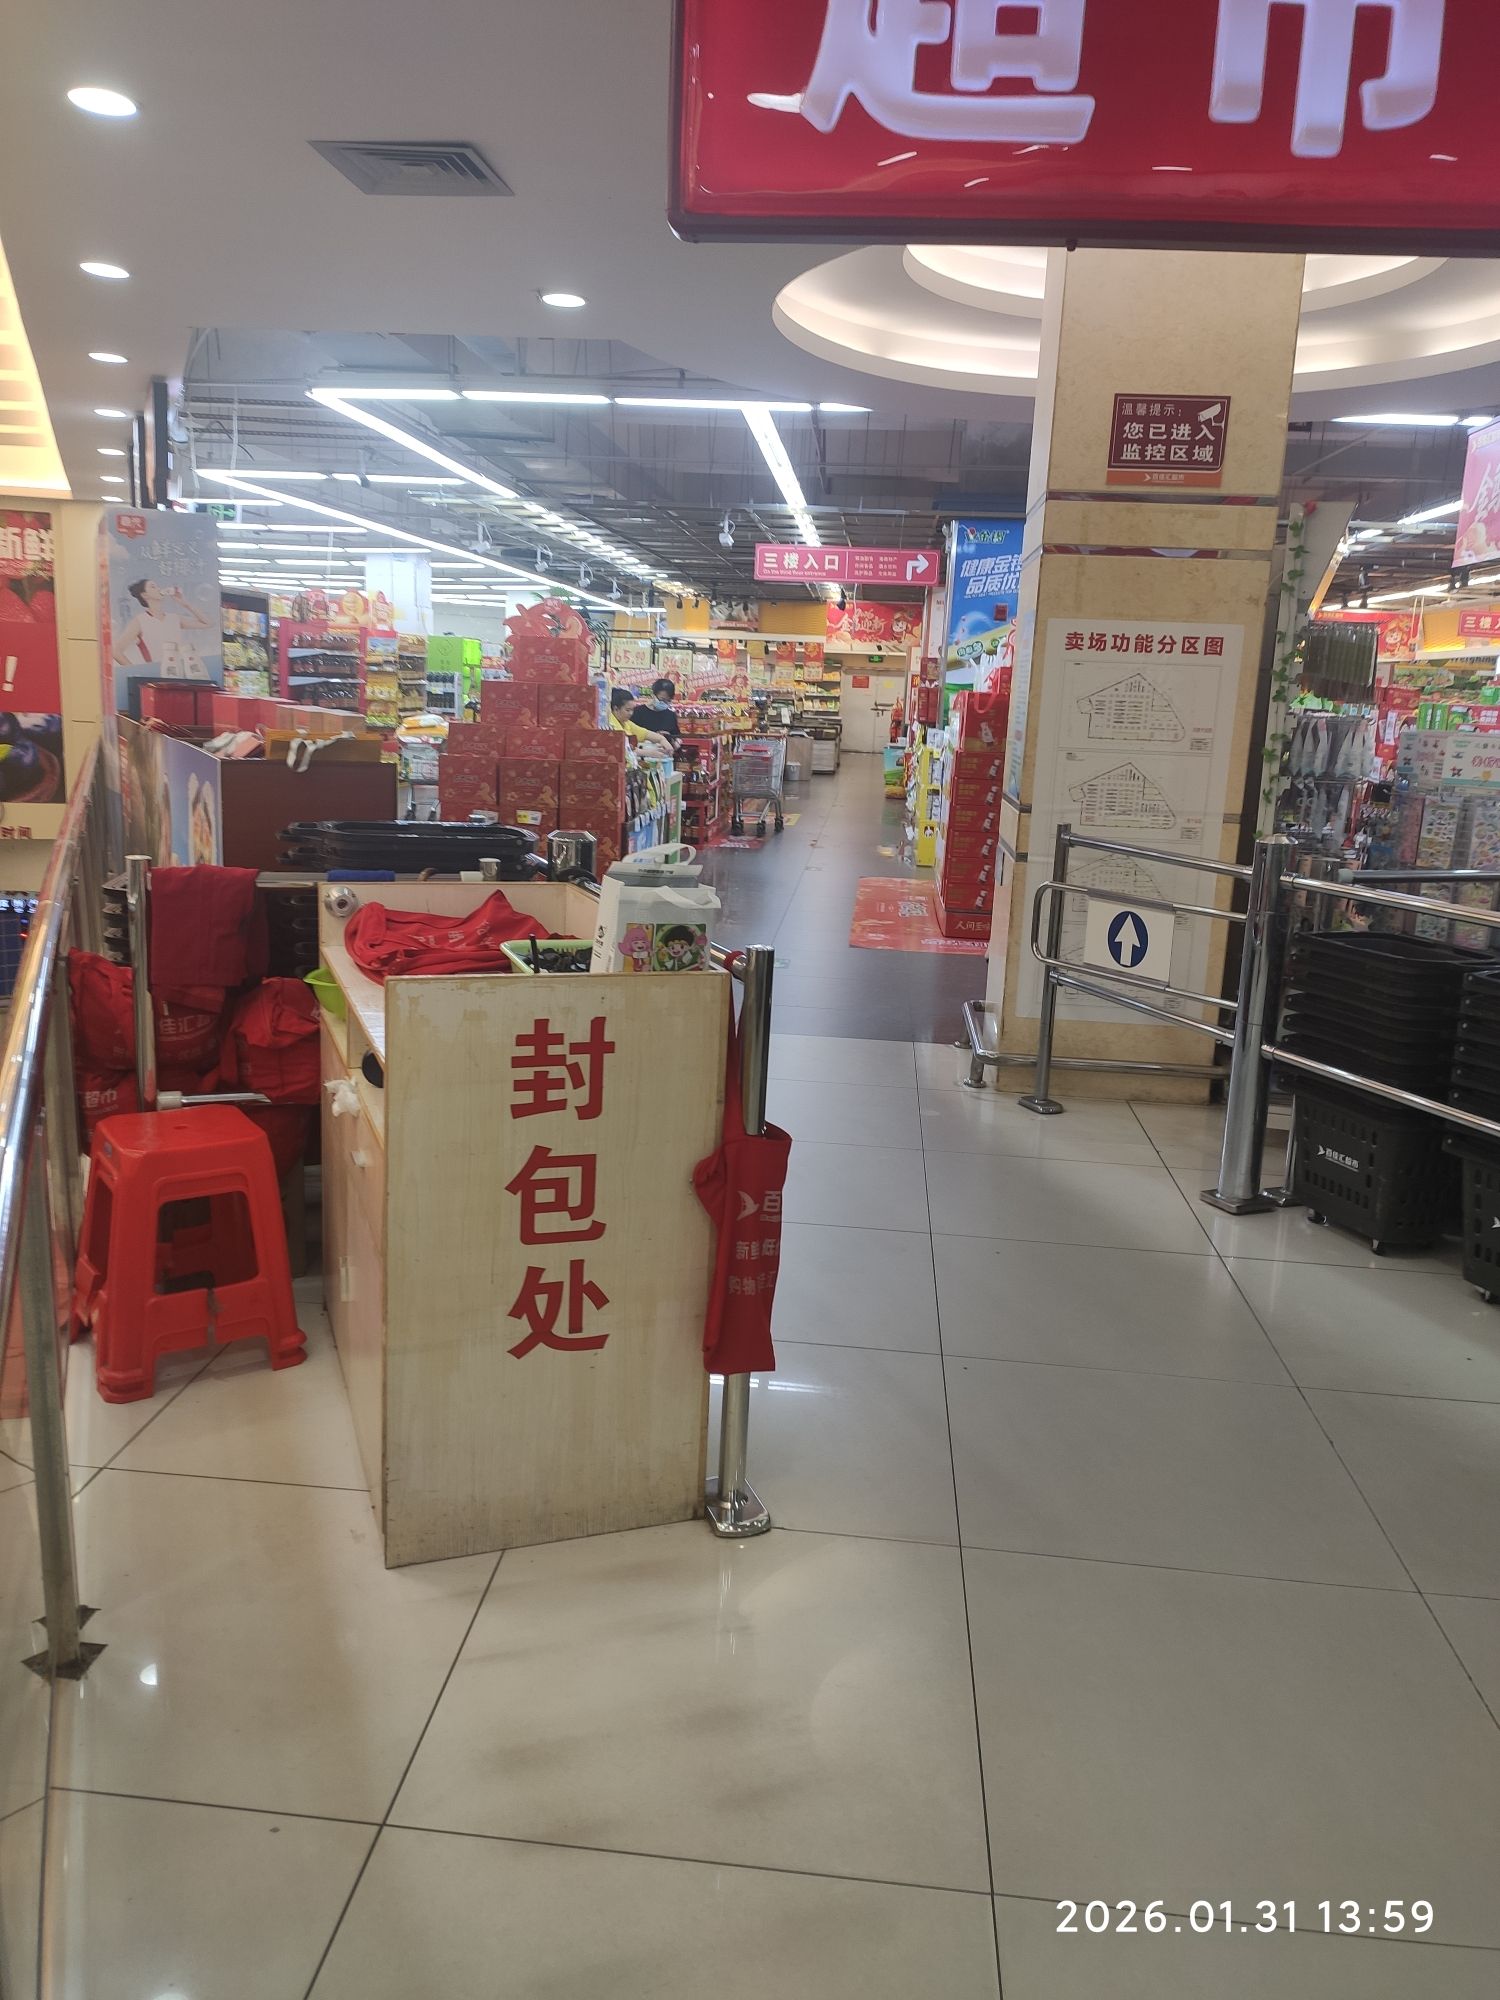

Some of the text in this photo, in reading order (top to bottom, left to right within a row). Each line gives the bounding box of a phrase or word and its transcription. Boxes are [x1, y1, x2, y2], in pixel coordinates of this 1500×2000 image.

[1122, 421, 1216, 441] 您已进入
[1120, 443, 1214, 462] 监控区域
[763, 552, 839, 571] 三楼入口
[1065, 631, 1225, 657] 卖场功能分区图
[504, 1016, 616, 1360] 封包处
